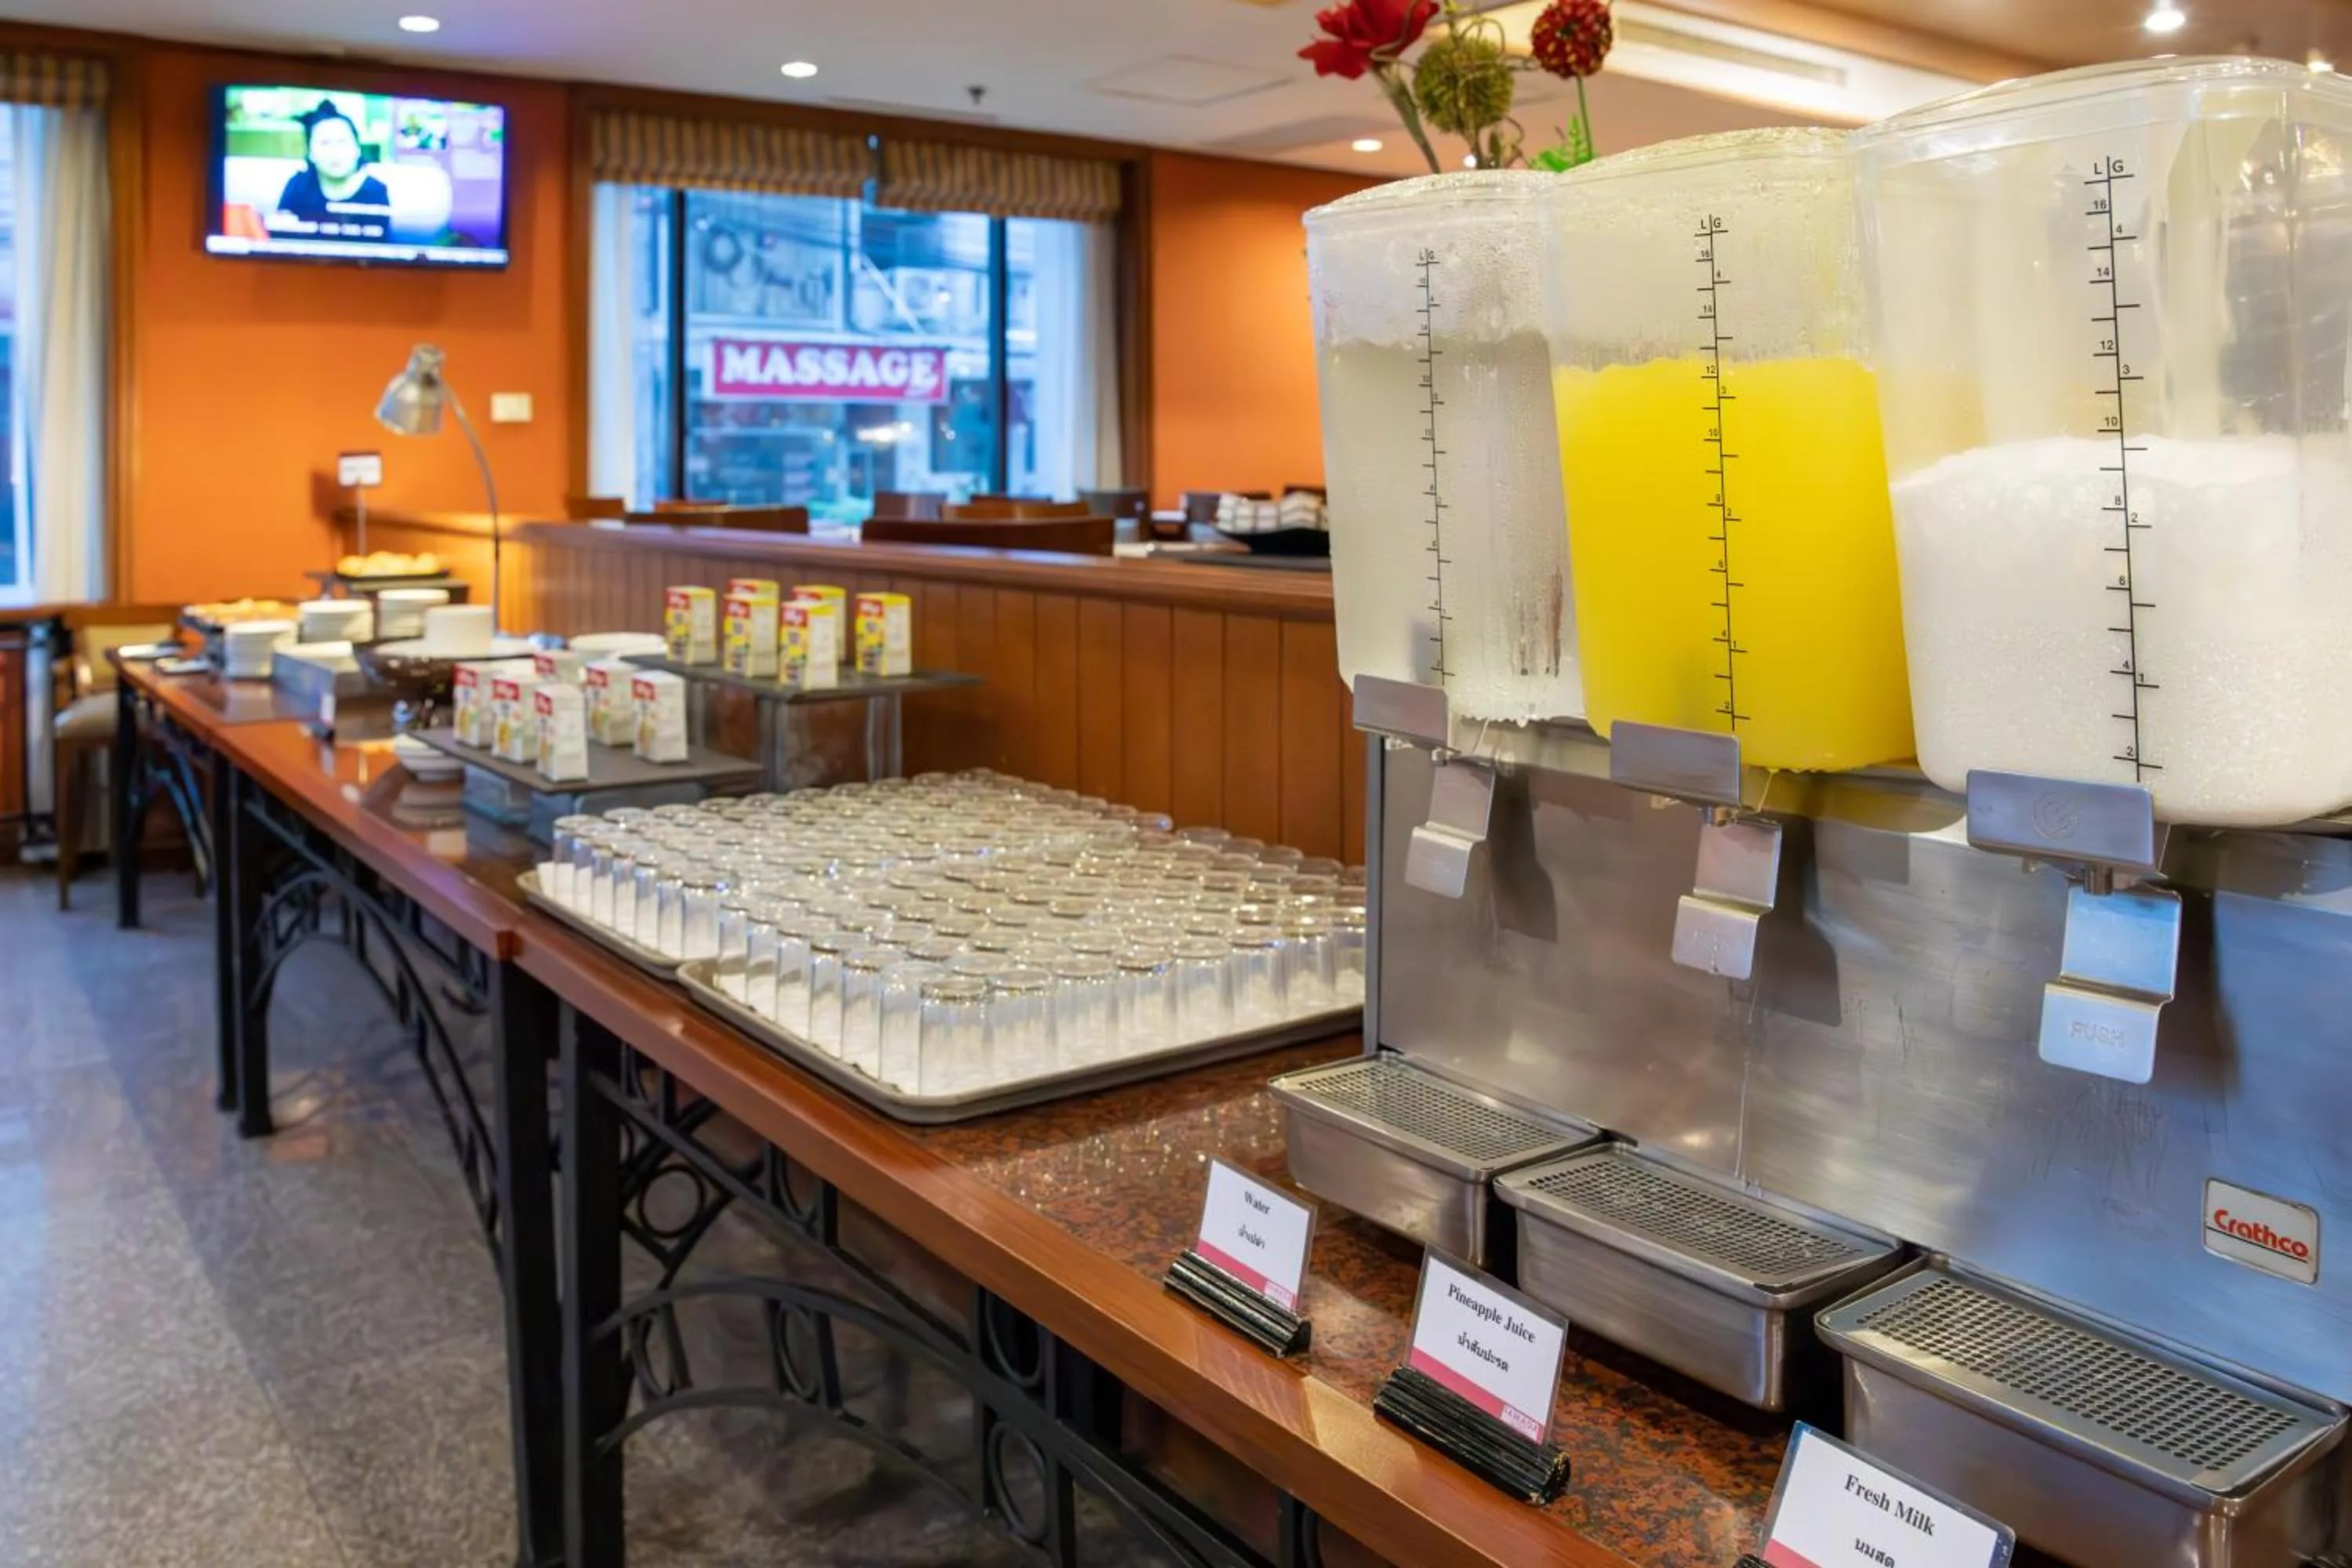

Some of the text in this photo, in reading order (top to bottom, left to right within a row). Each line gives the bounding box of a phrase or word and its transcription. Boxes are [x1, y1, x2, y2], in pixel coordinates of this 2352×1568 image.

[2094, 160, 2124, 175] L G
[1700, 218, 1721, 230] L G
[2115, 224, 2122, 234] 4
[2096, 267, 2110, 277] 14
[2100, 340, 2114, 350] 12
[721, 343, 939, 390] MASSAGE
[1706, 365, 1715, 375] 12
[2123, 365, 2130, 374] 3
[2104, 416, 2118, 427] 10
[2131, 513, 2138, 523] 2
[2118, 575, 2125, 586] 6
[2122, 659, 2129, 670] 4
[2139, 673, 2144, 683] 1
[2126, 746, 2133, 757] 2
[2070, 1021, 2125, 1048] PUSH
[1244, 1191, 1271, 1214] Water
[2213, 1208, 2309, 1258] Crathco
[1448, 1282, 1537, 1343] Pineapple Juice
[1844, 1474, 1935, 1537] Fresh Milk
